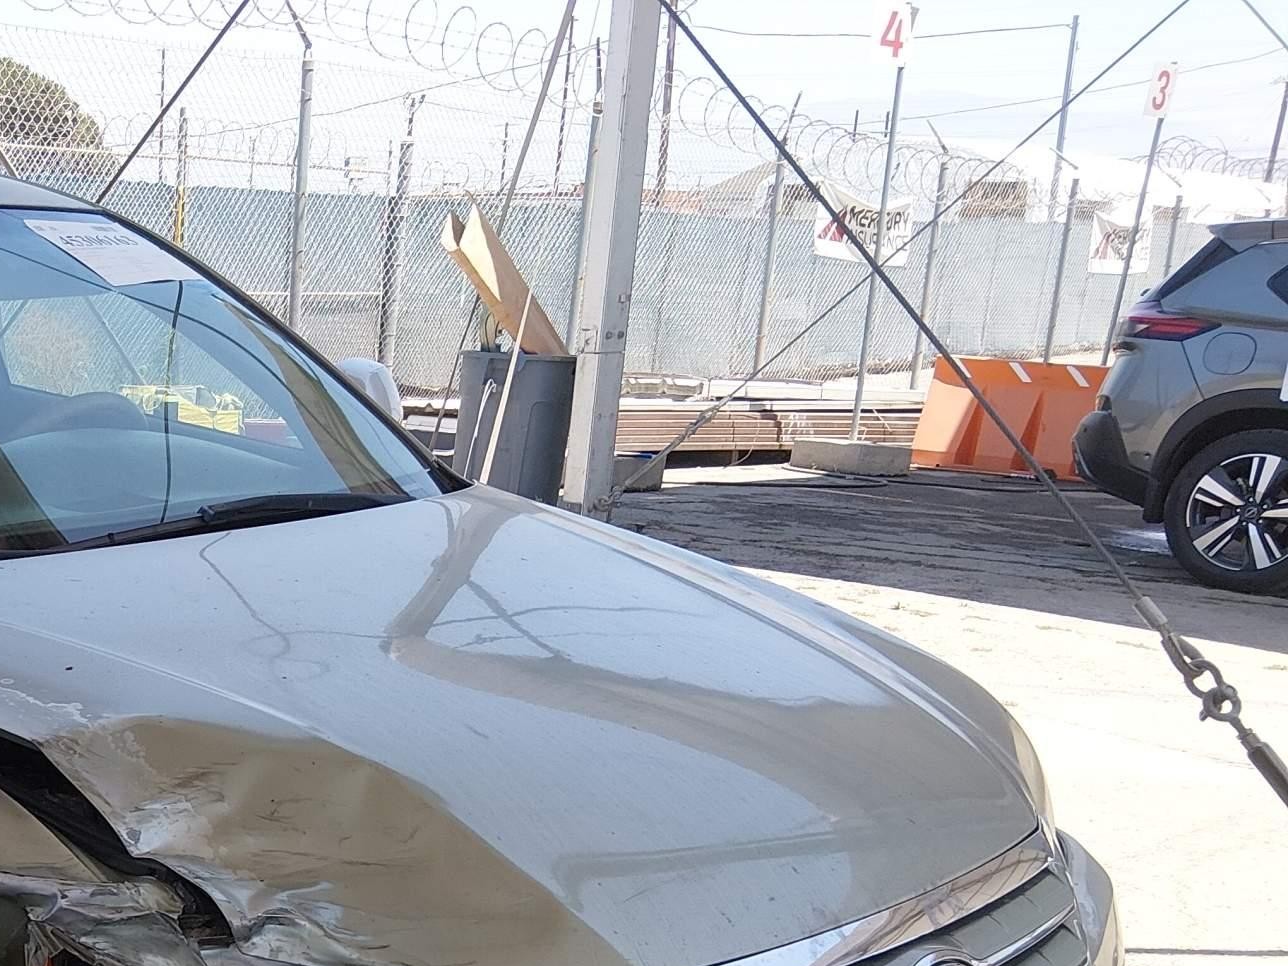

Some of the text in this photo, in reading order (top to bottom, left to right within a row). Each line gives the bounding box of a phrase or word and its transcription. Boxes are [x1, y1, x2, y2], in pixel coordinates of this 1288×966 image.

[879, 10, 904, 58] 4
[1151, 69, 1171, 111] 3
[848, 205, 911, 233] MERURY
